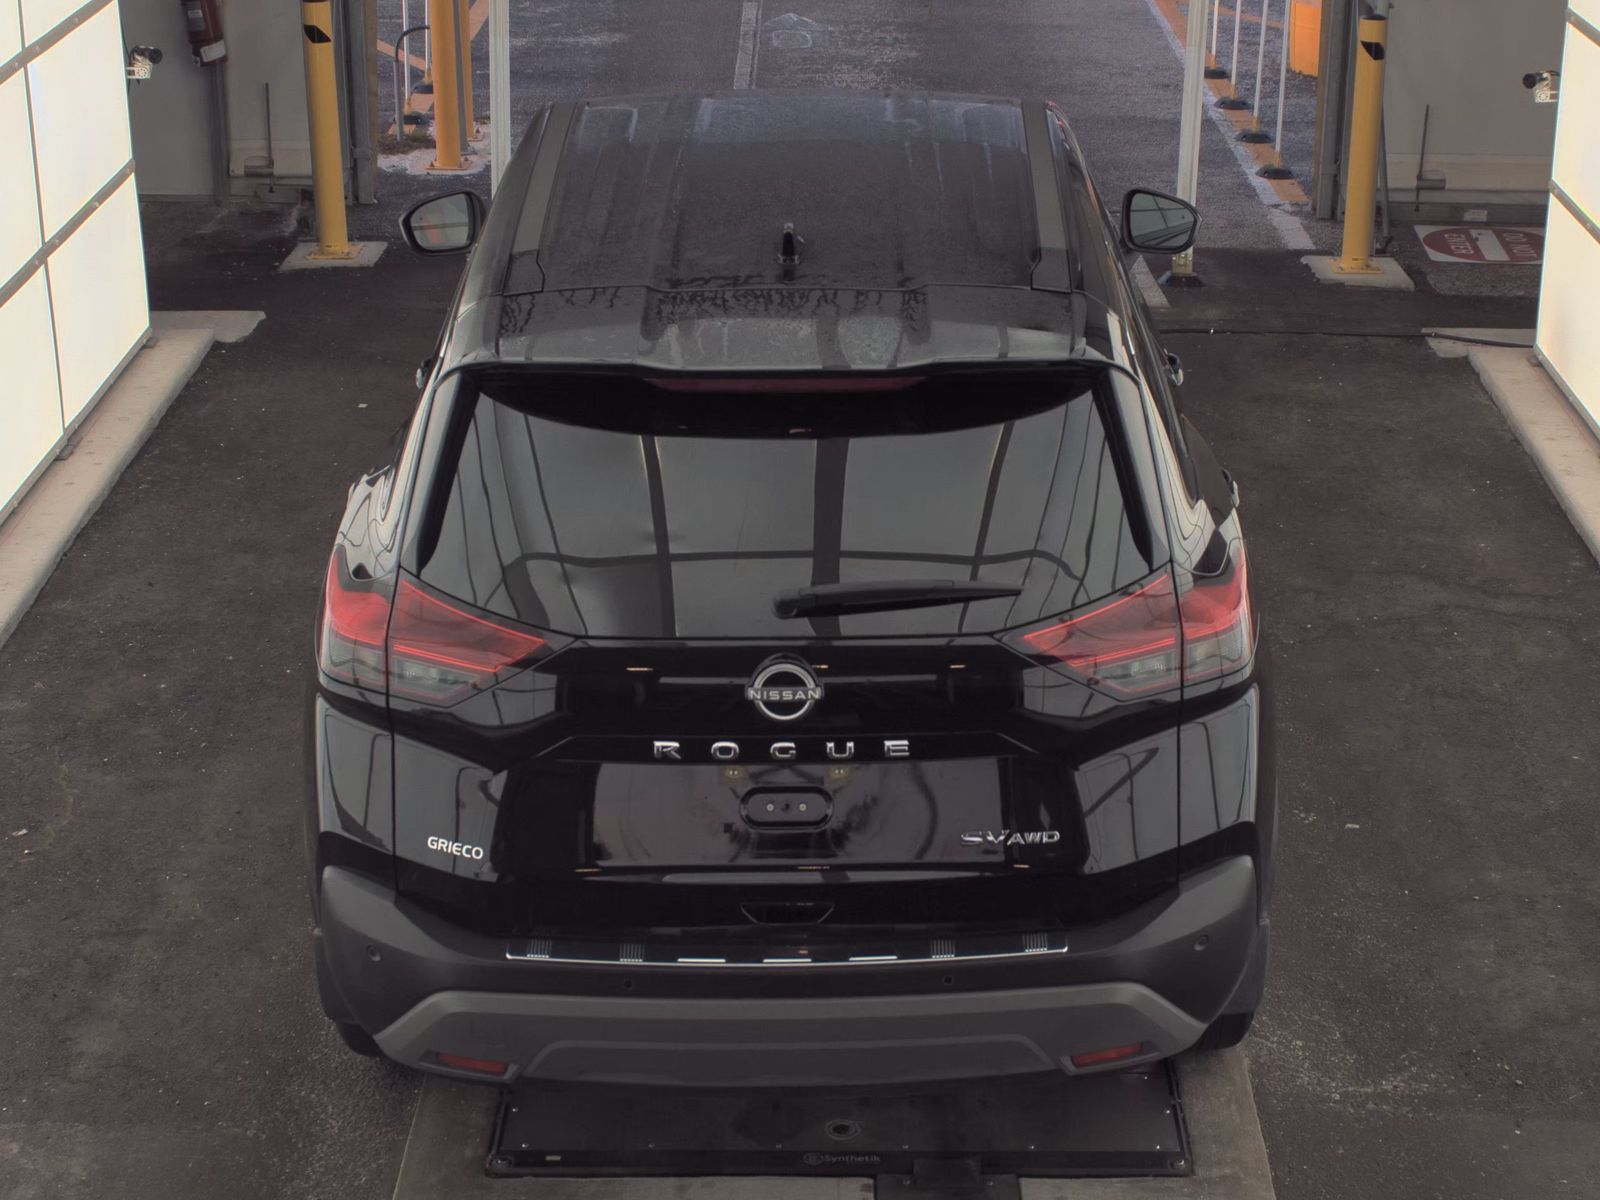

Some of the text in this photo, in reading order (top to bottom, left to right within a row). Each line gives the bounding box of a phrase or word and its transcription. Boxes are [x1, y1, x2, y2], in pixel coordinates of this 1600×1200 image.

[1443, 232, 1475, 256] ENTER
[1502, 232, 1538, 258] DO NOT
[748, 688, 821, 701] NISSAN
[653, 739, 910, 760] ROGUE
[427, 836, 484, 860] GRIECO
[961, 829, 1061, 846] SV AWD
